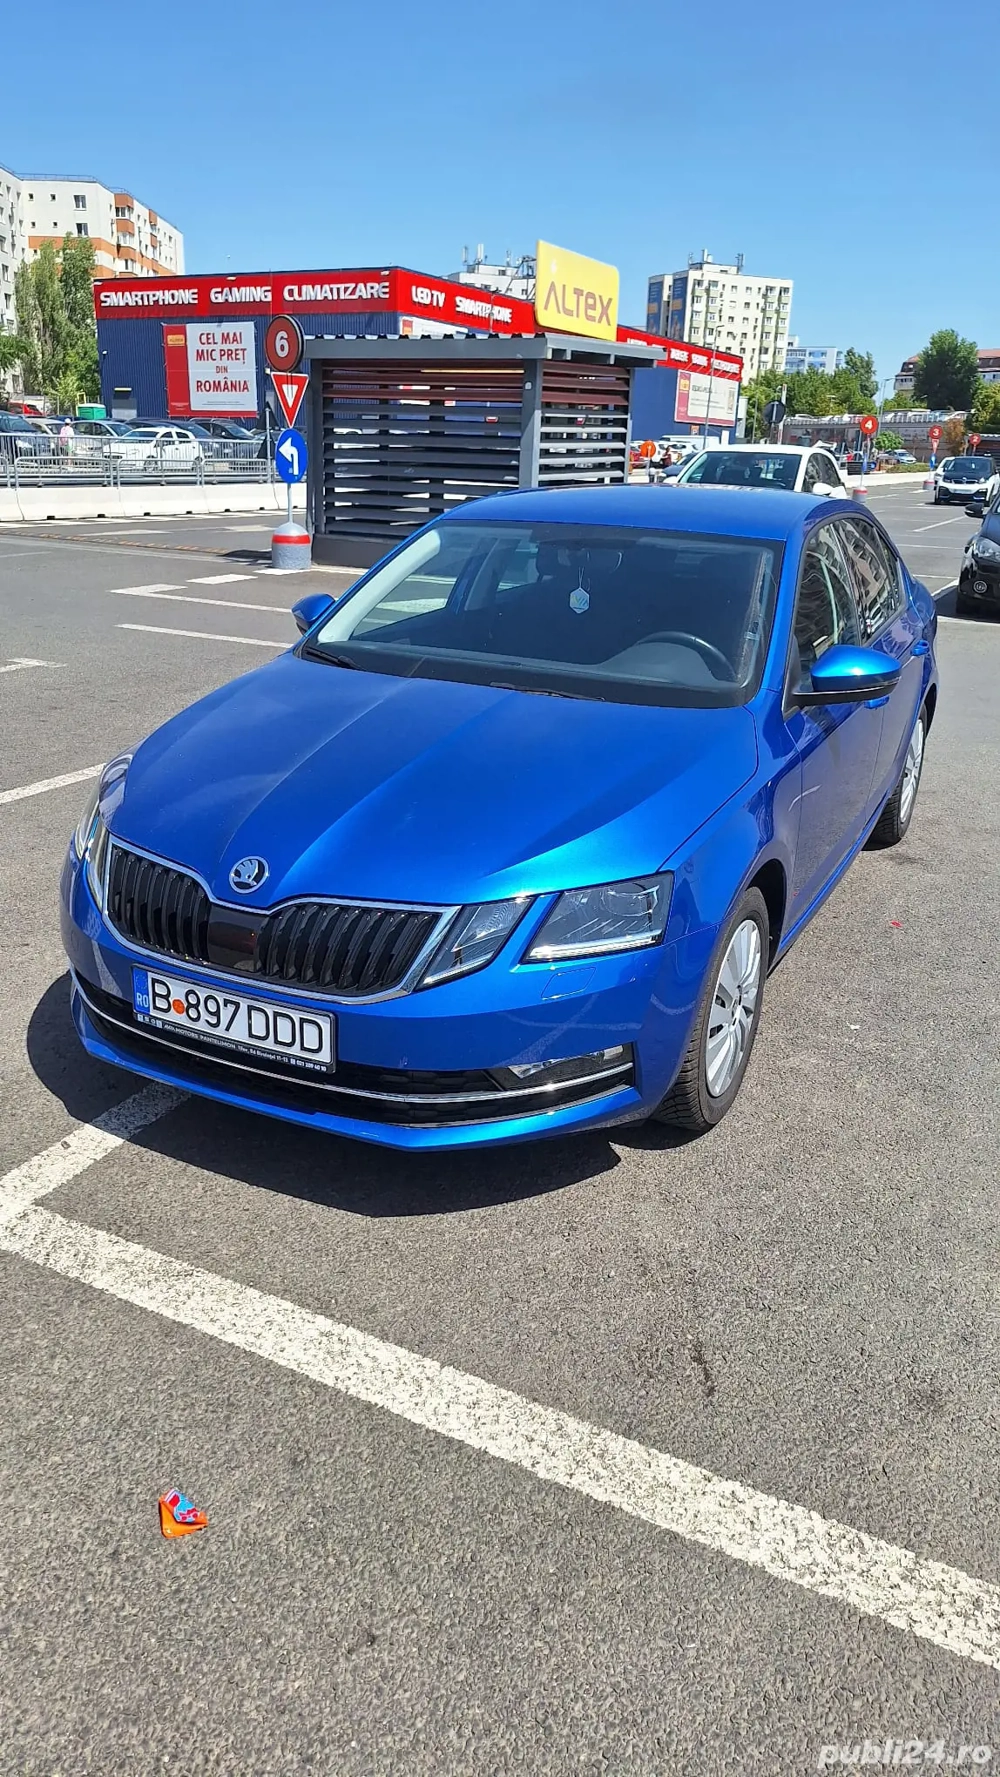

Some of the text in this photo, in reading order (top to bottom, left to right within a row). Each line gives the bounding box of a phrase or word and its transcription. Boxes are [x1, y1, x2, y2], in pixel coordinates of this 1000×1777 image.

[100, 281, 390, 307] SMARTPHONE GAMING CLIMATIZARE
[411, 285, 512, 323] LED TV SMARTPHONE
[199, 332, 218, 346] CEL
[221, 331, 242, 345] MAI
[275, 331, 289, 358] 6
[196, 348, 217, 361] MIC
[215, 365, 228, 374] DIN
[196, 377, 249, 393] ROMÂNIA
[864, 420, 873, 429] 4
[932, 428, 939, 436] 3
[136, 992, 149, 1008] RO
[151, 977, 324, 1054] B 897 DDD
